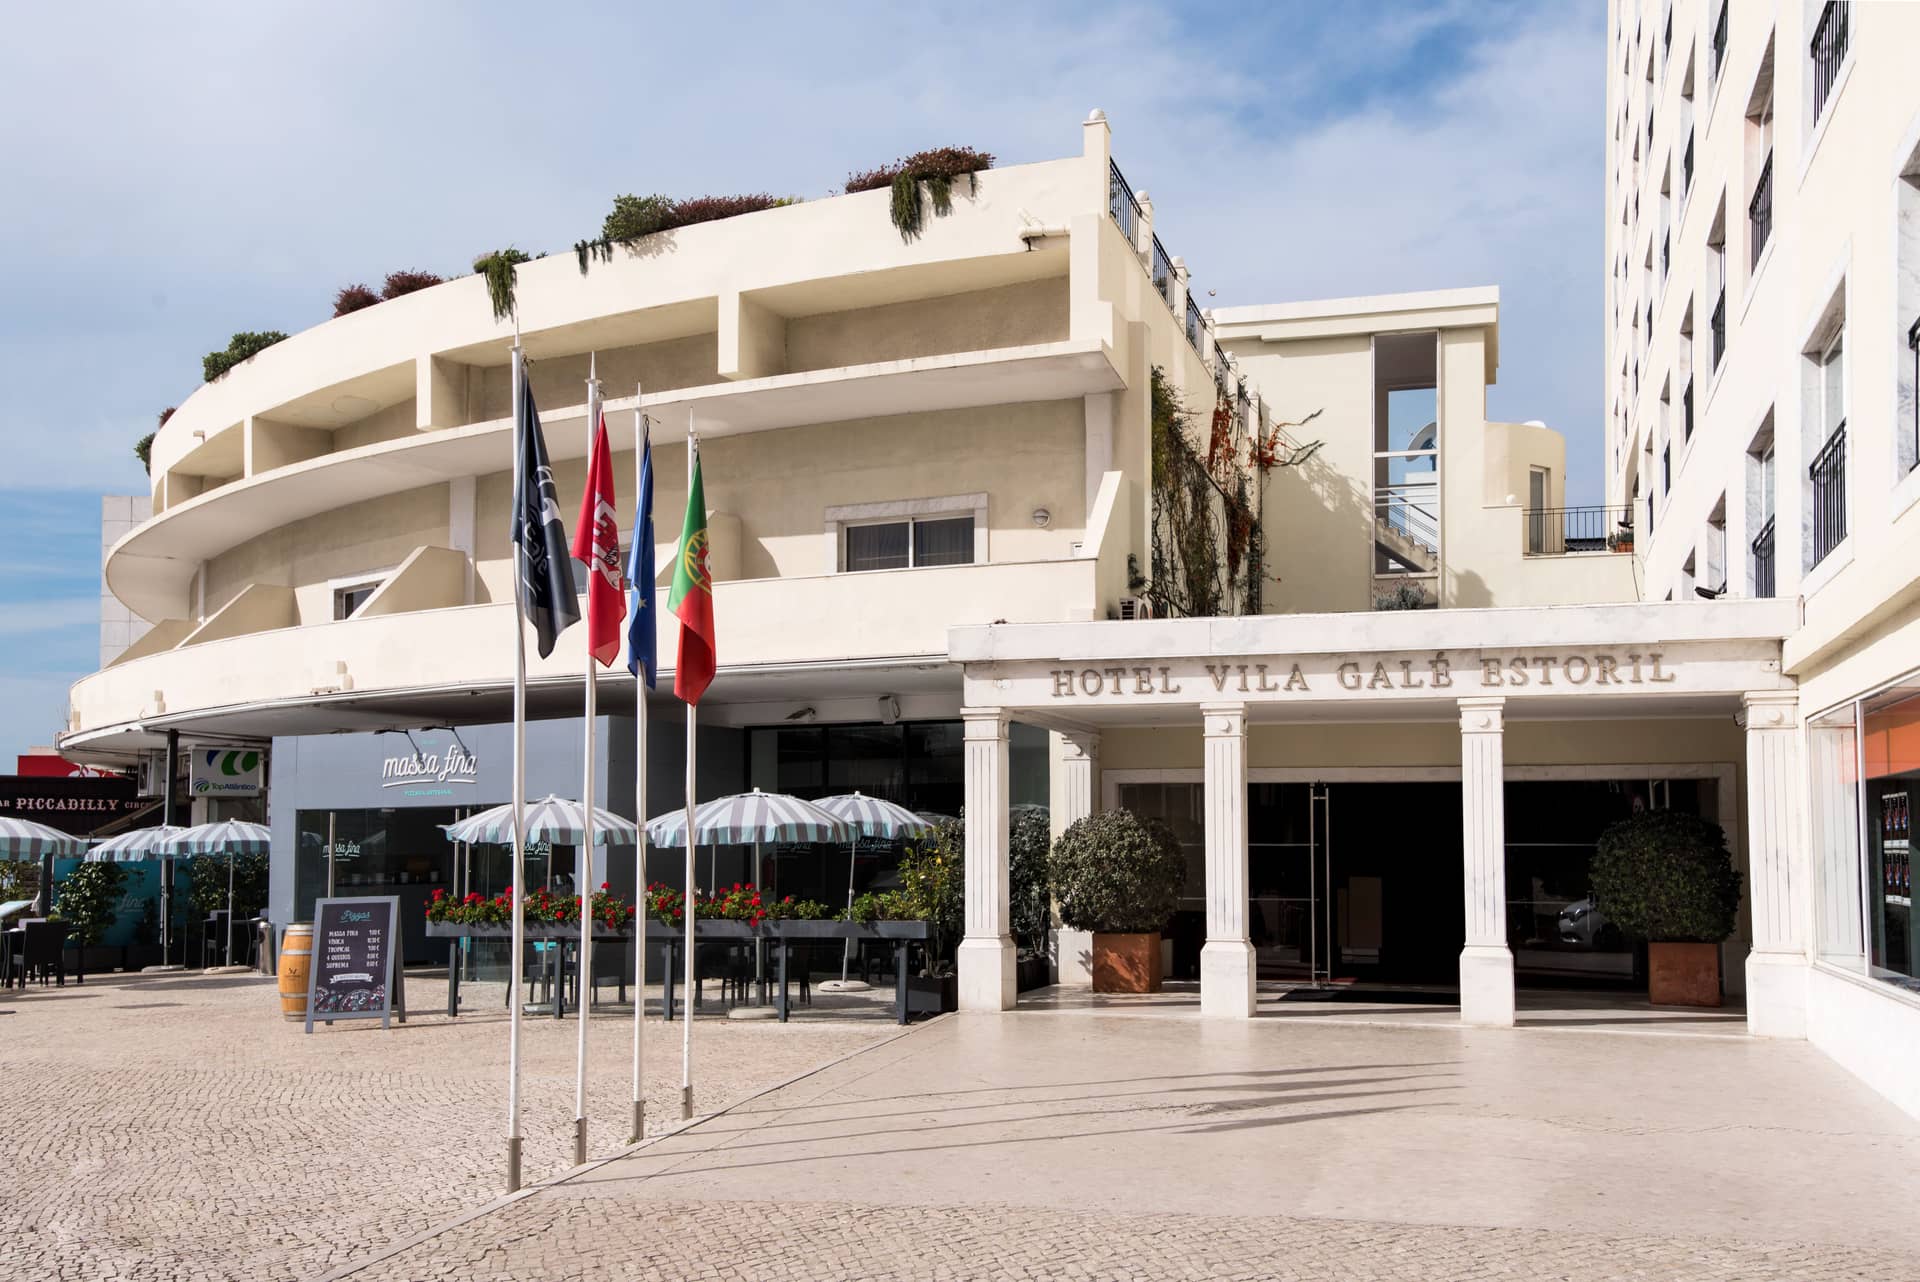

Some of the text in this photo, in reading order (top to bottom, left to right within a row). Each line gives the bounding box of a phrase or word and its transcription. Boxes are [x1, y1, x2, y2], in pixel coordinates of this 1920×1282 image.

[1050, 651, 1676, 697] HOTEL VILA GALÉ ESTORIL
[382, 744, 477, 782] massa fina
[16, 798, 119, 810] PICCADILLY
